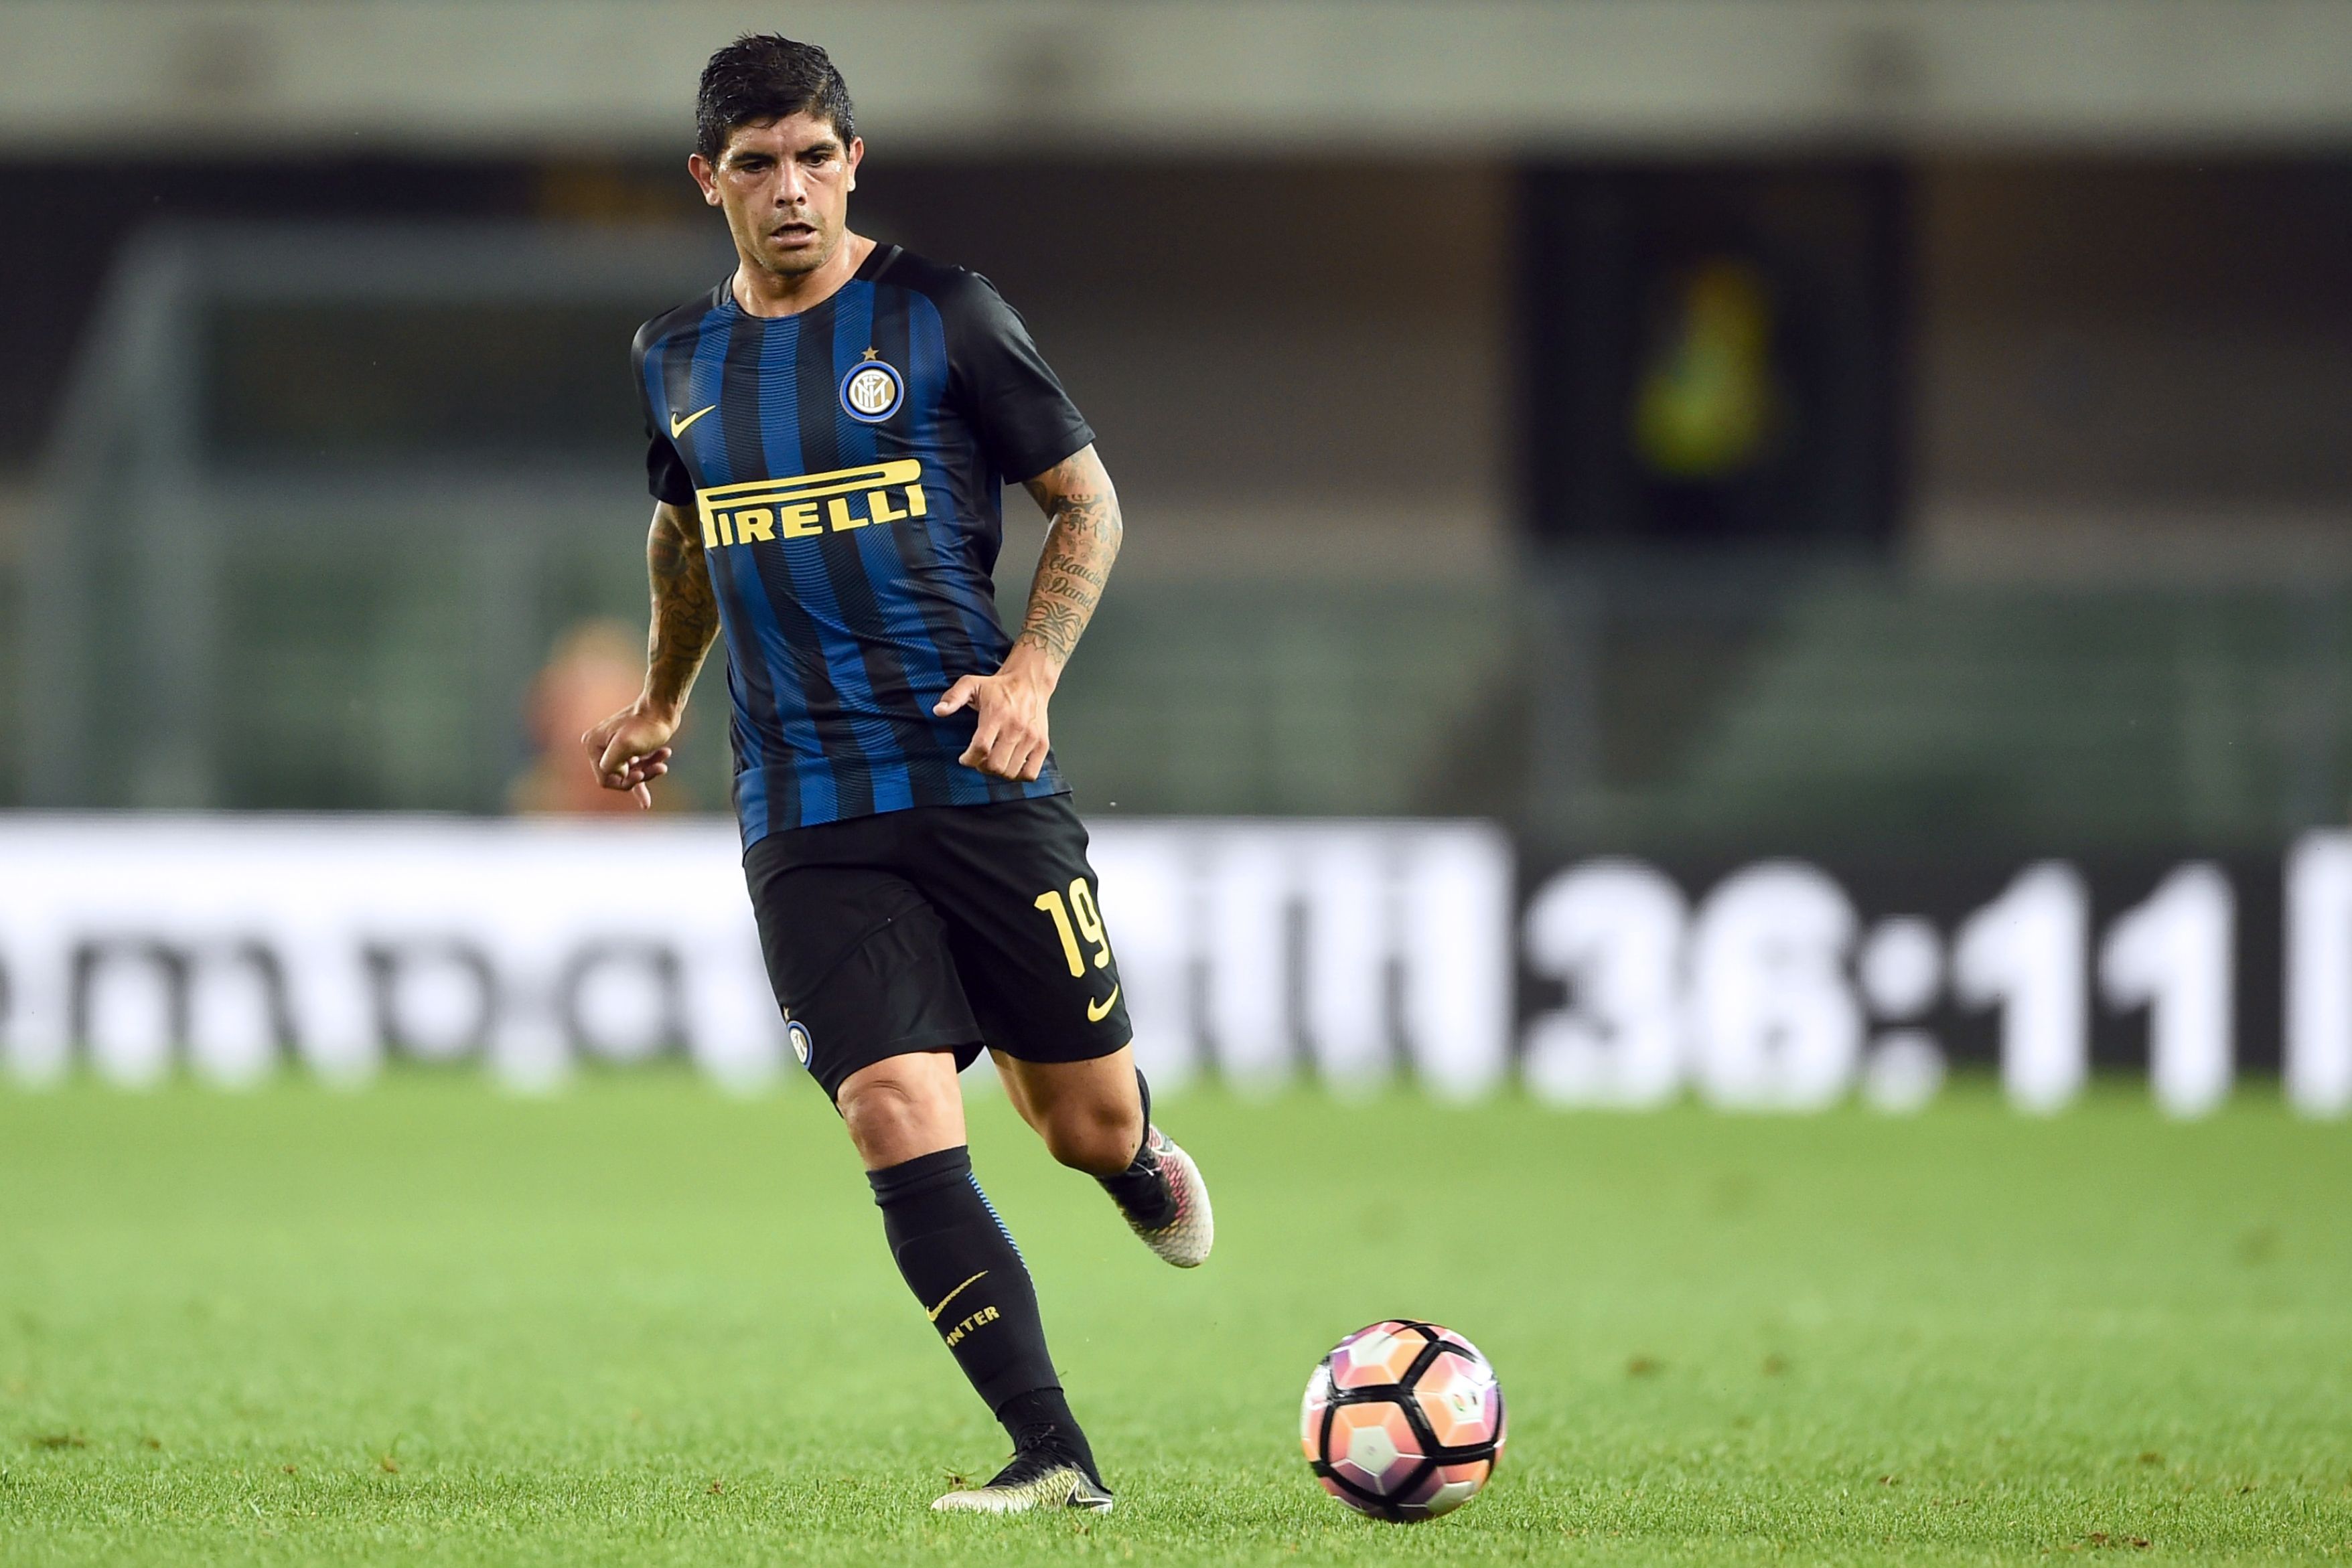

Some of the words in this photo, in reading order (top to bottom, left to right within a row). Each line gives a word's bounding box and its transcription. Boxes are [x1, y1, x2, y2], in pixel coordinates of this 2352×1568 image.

[696, 459, 927, 548] PIRELLI
[1034, 877, 1110, 978] 19
[1522, 856, 2235, 1119] 36:11
[946, 1306, 1001, 1347] INTER
